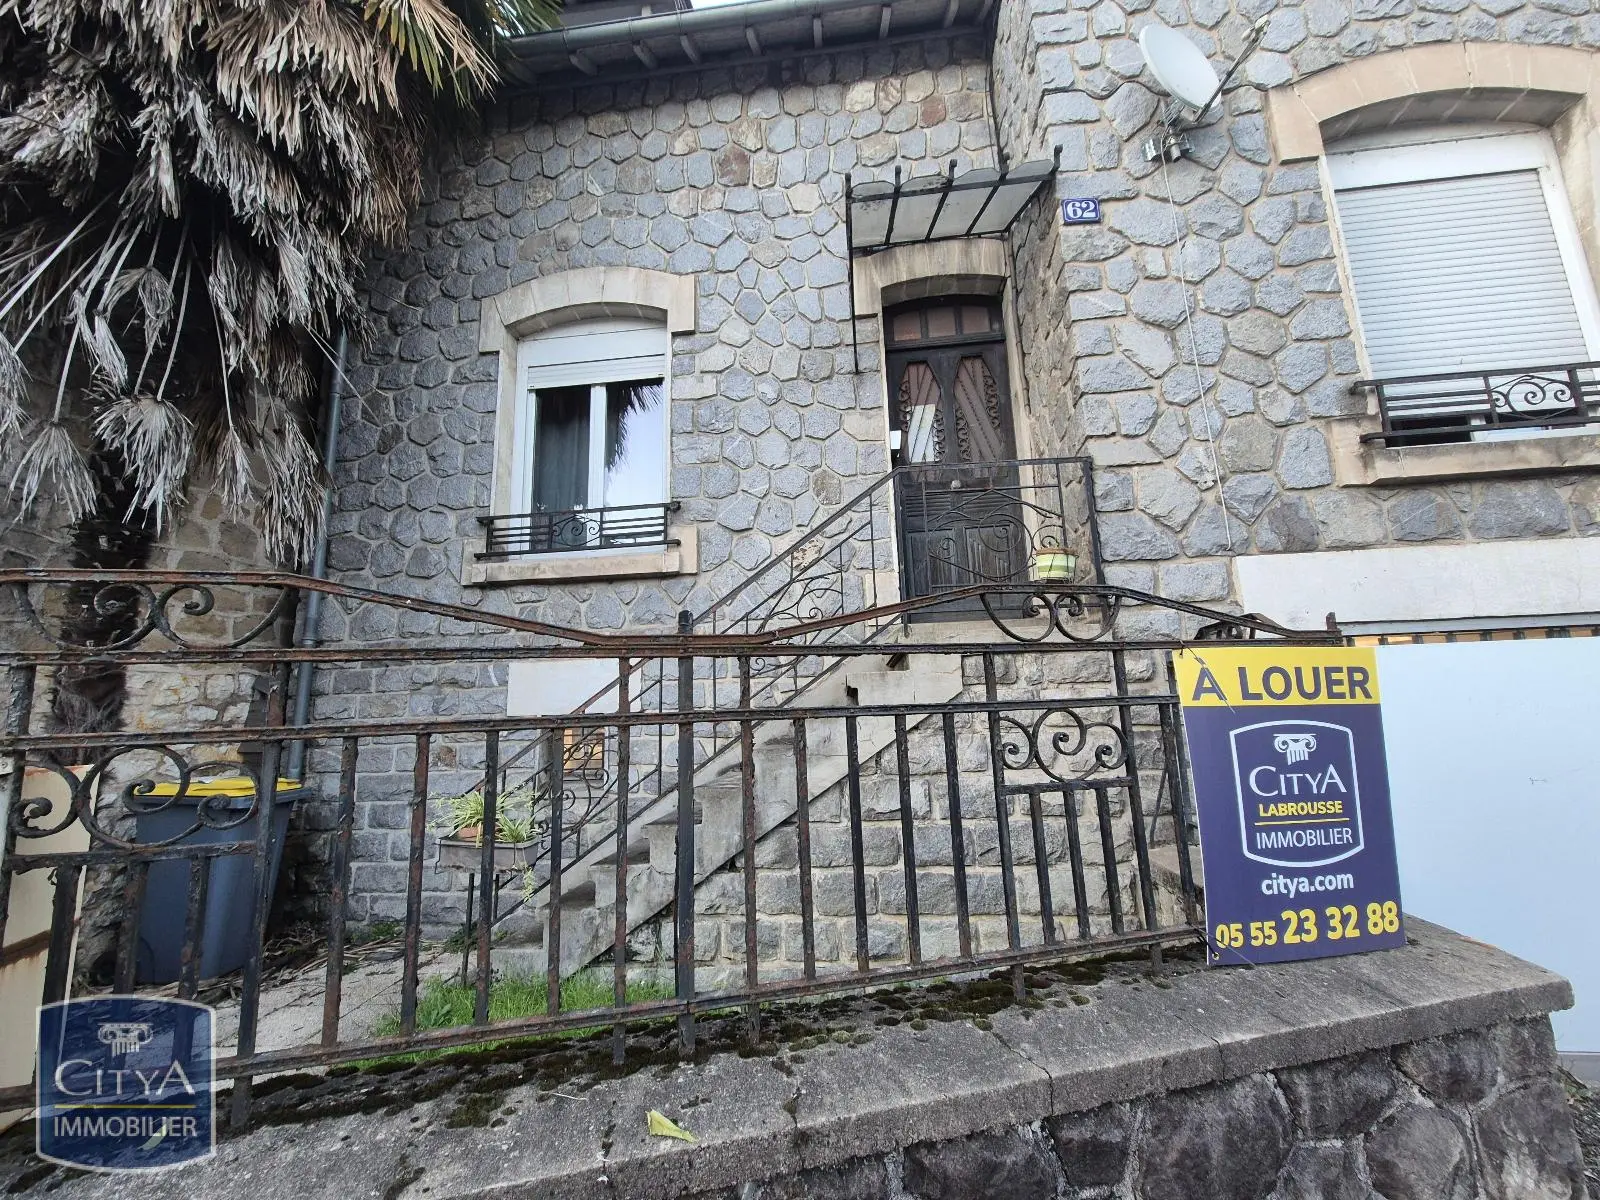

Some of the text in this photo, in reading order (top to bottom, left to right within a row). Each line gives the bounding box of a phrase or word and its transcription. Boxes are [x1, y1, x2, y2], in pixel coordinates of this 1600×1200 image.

[1066, 200, 1097, 219] 62
[1238, 666, 1373, 701] LOUER
[1259, 801, 1343, 818] LABROUSSE
[1256, 828, 1353, 849] IMMOBILIER
[1261, 872, 1354, 898] citya.com
[1215, 900, 1399, 949] 05 55 23 32 88
